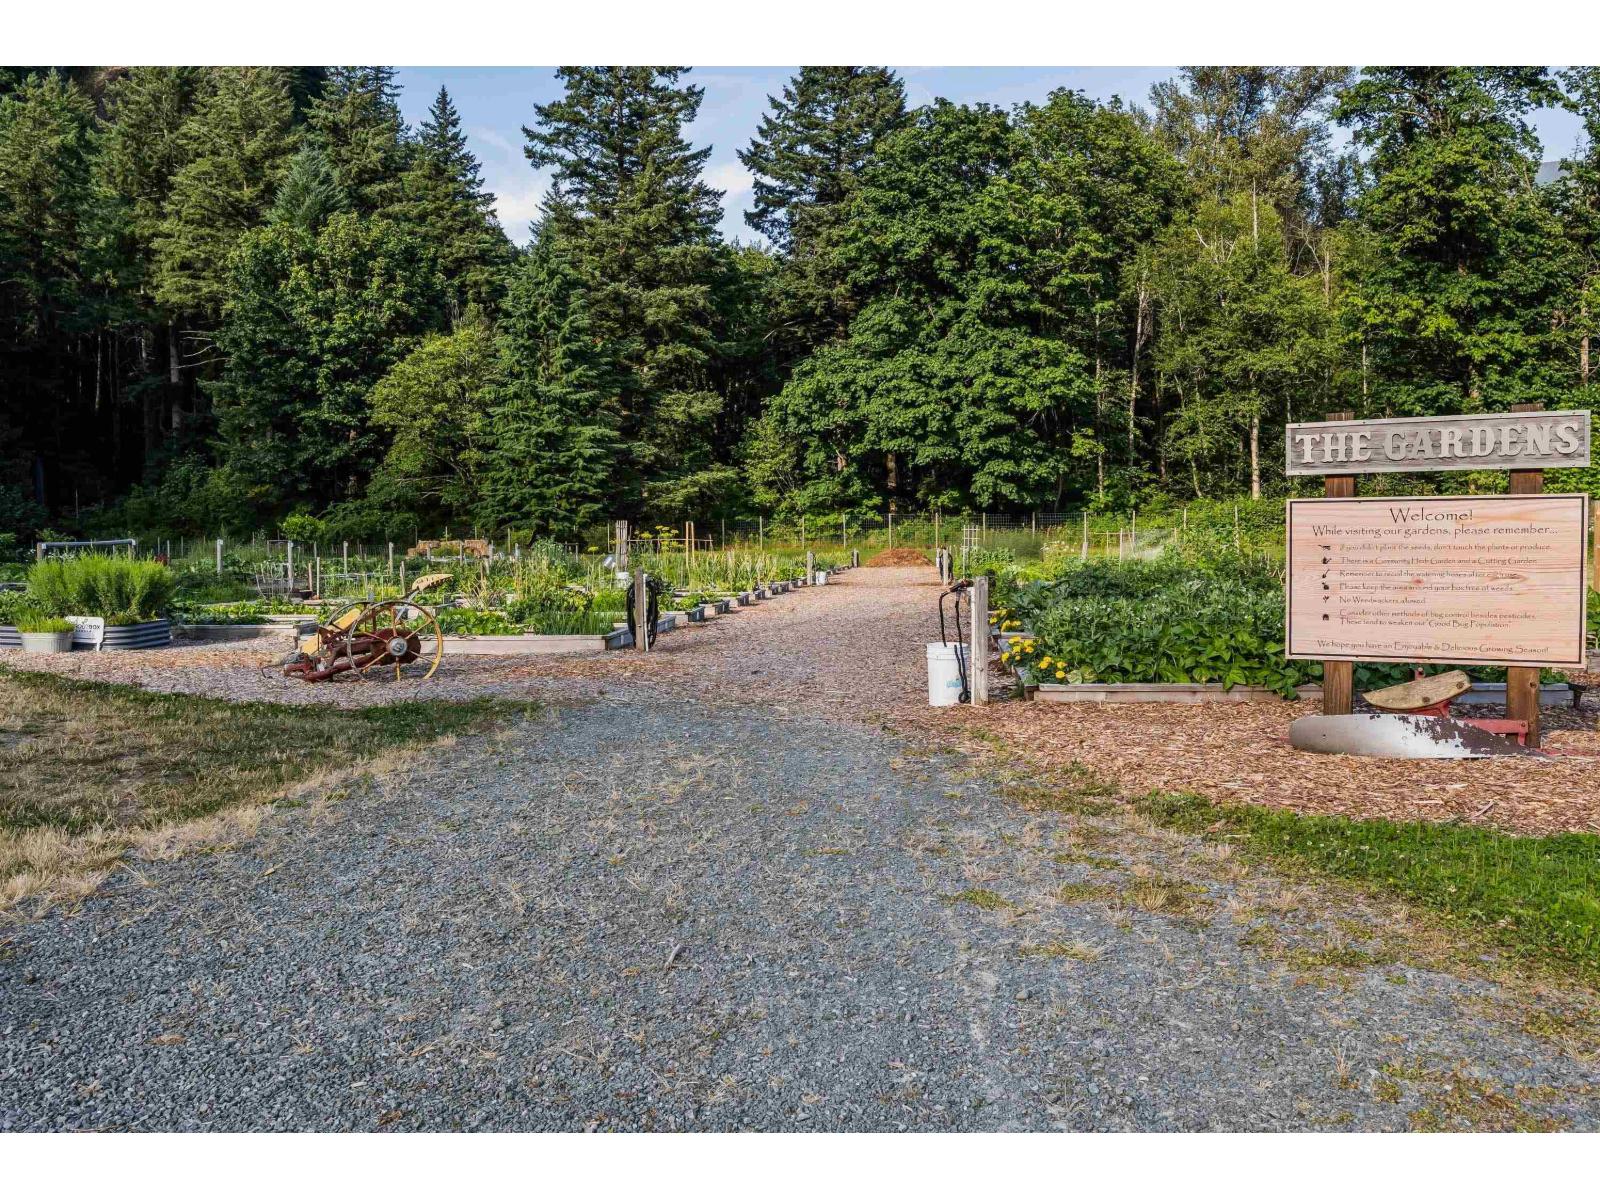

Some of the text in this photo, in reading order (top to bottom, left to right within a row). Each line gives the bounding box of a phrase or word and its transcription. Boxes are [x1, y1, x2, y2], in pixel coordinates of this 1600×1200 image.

[1295, 422, 1580, 464] THE GARDENS
[1390, 507, 1473, 524] Welcome!
[1312, 525, 1343, 536] While
[1345, 526, 1382, 539] visiting
[1403, 524, 1452, 539] gardens,
[1454, 523, 1490, 539] please
[1493, 523, 1559, 535] remember...
[1487, 543, 1509, 552] plants
